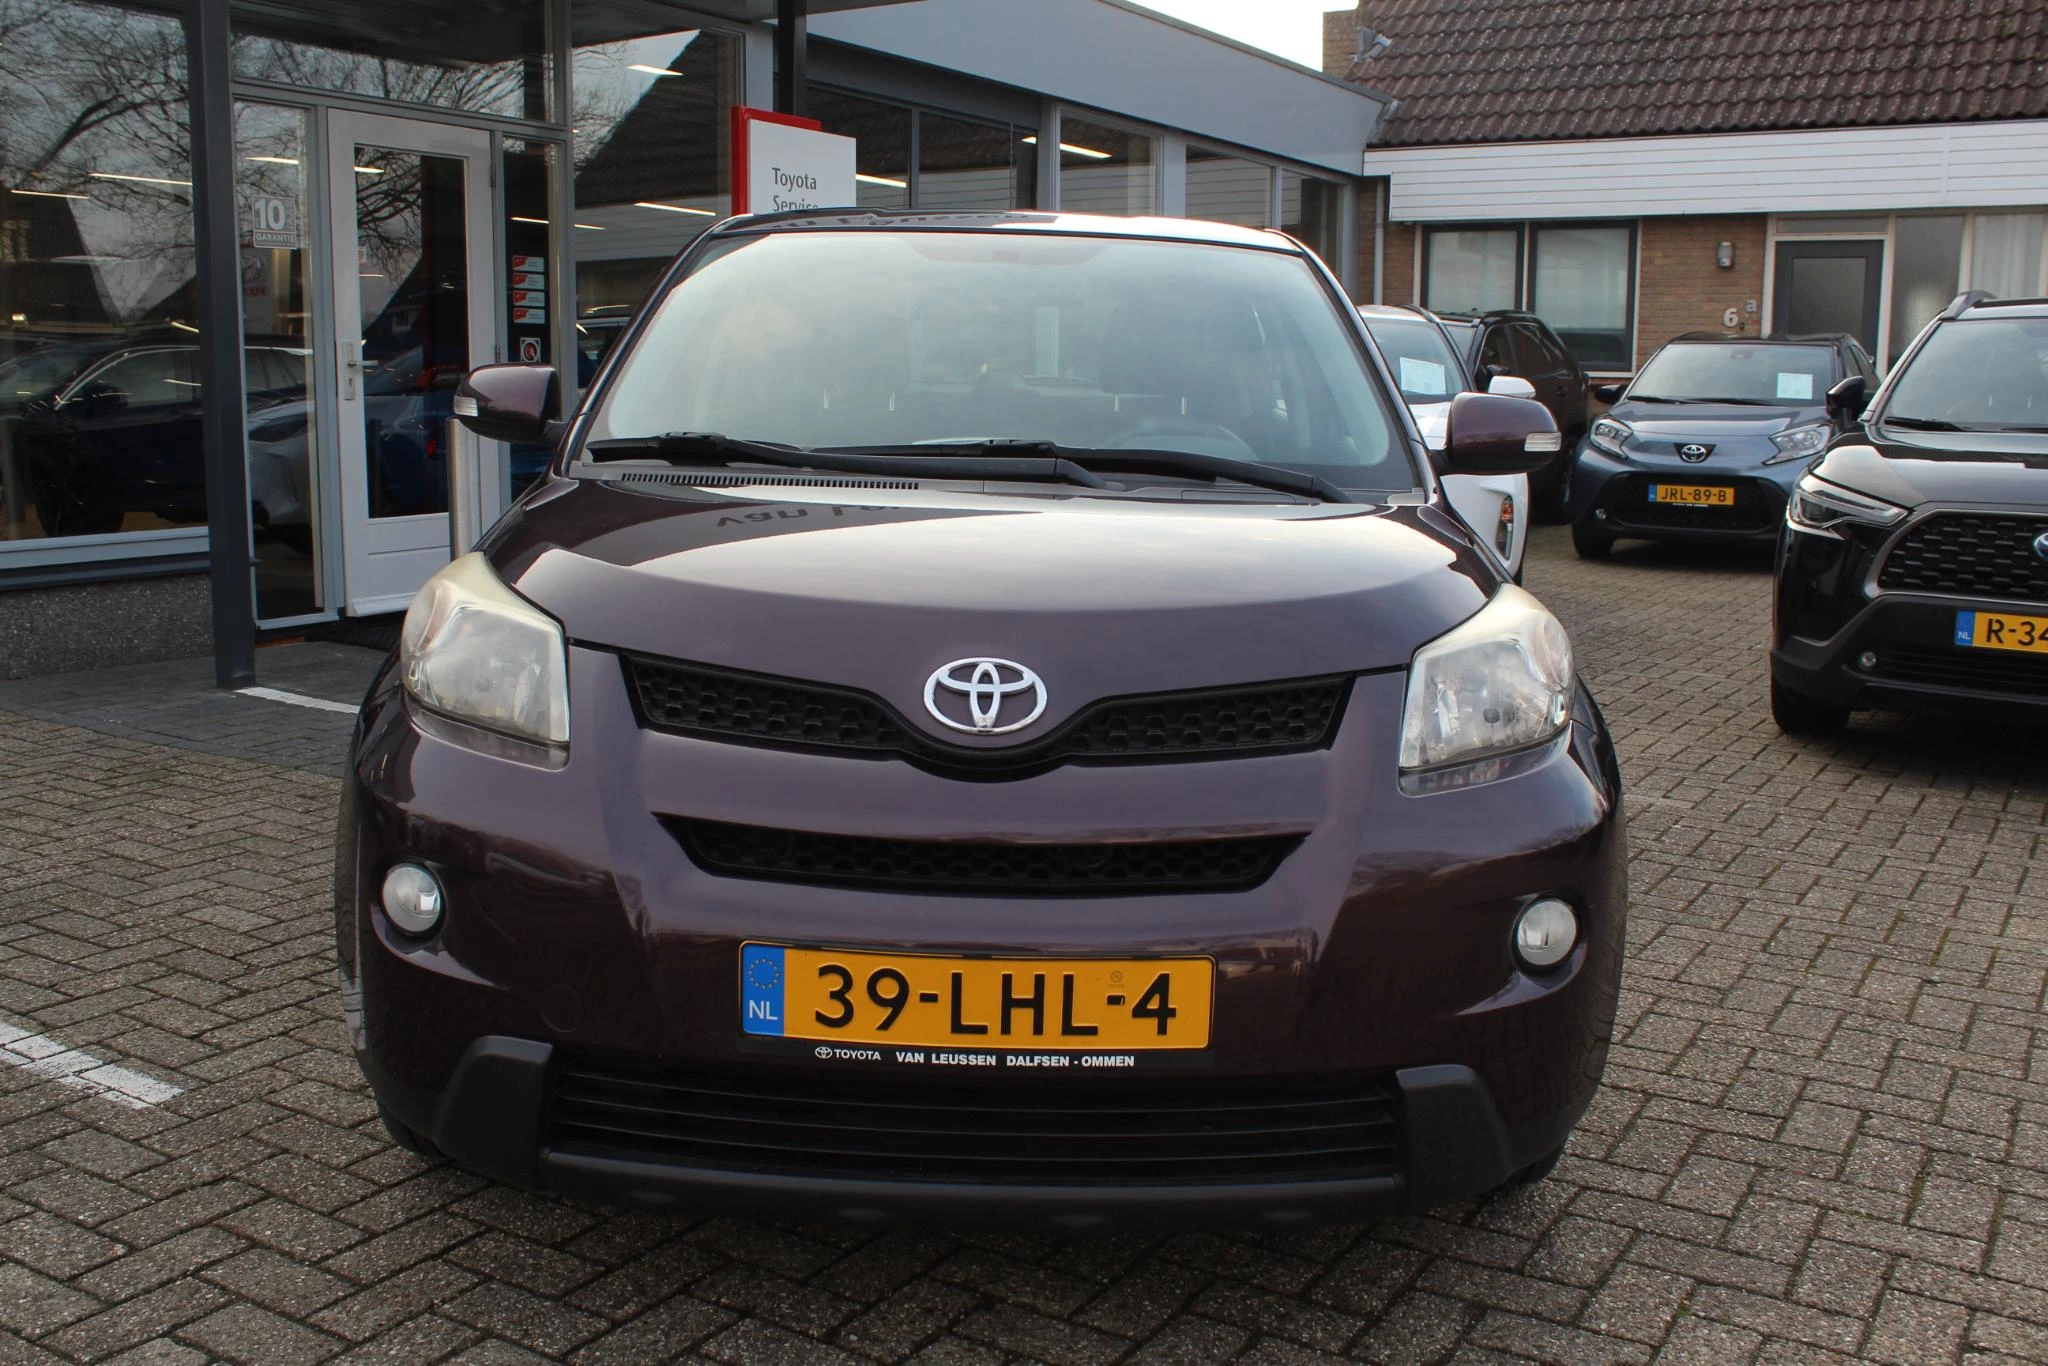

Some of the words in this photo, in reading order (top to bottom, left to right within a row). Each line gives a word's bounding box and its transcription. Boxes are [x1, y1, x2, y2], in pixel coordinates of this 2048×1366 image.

[772, 167, 817, 192] Toyota
[255, 199, 286, 230] 10
[256, 233, 295, 243] GARANTIE
[1723, 307, 1738, 327] 6
[1661, 487, 1727, 502] JRL-89-B
[1958, 631, 1971, 640] NL
[815, 964, 1177, 1036] 39-LHL-4
[749, 1000, 778, 1021] NL
[834, 1049, 882, 1061] TOYOTA
[896, 1052, 924, 1063] VAN
[931, 1053, 996, 1066] LEUSSEN
[1006, 1055, 1069, 1067] DALFSEN
[1081, 1056, 1134, 1067] OMMEN
